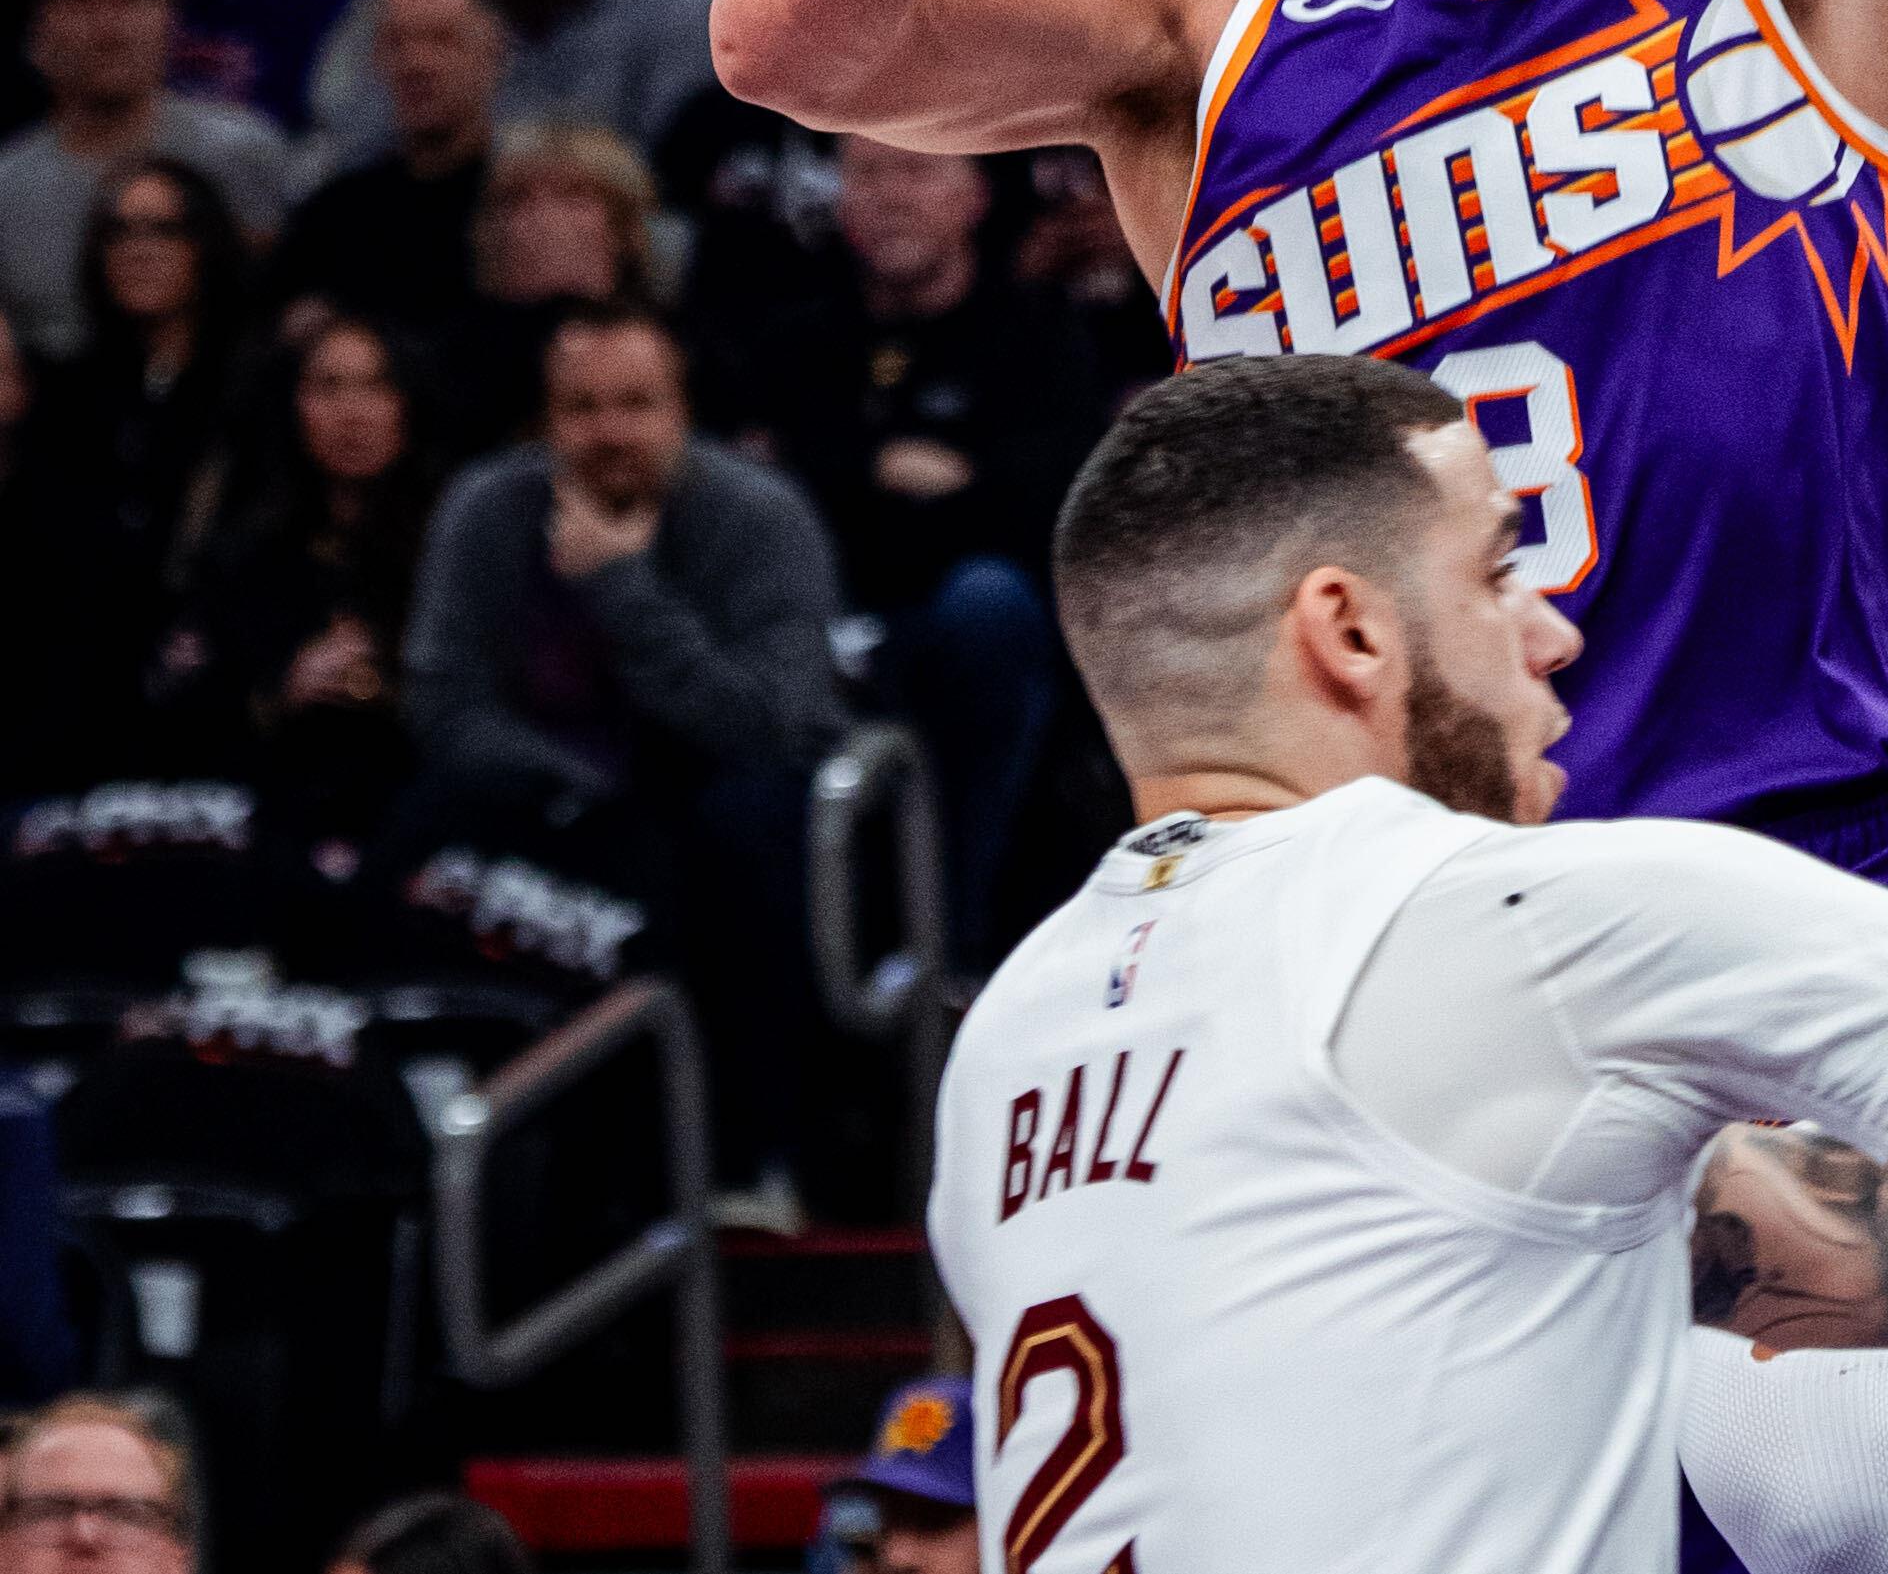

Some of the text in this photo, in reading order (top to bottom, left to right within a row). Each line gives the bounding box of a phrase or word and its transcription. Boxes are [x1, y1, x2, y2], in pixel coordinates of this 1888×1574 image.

[1180, 53, 1670, 356] SUNS
[998, 1048, 1187, 1224] BALL
[995, 1293, 1138, 1574] 2
